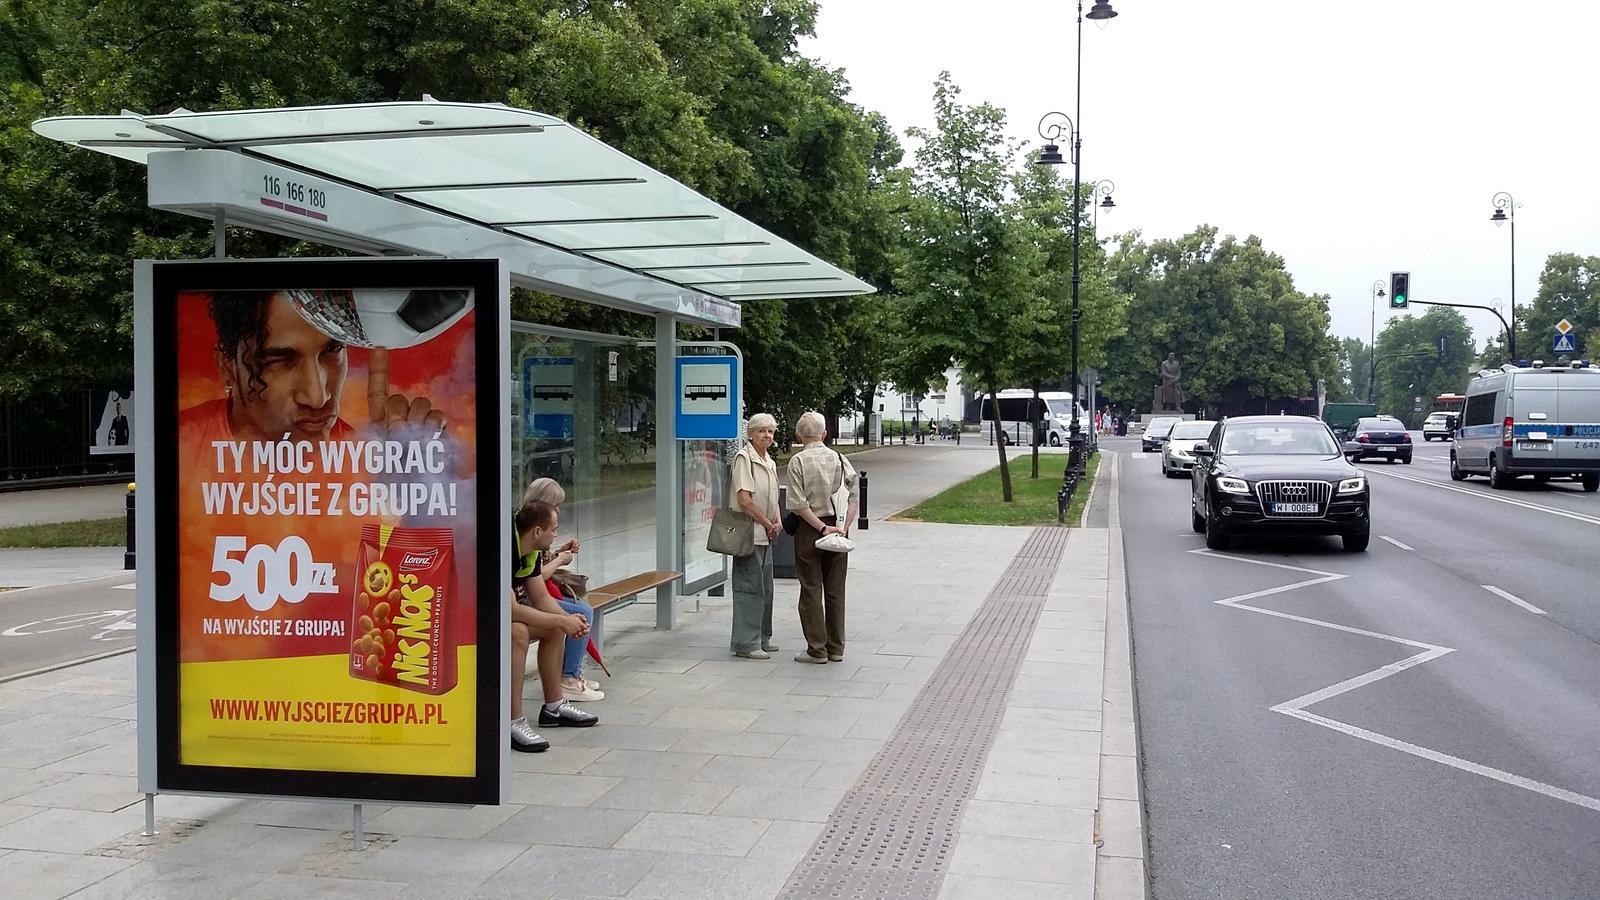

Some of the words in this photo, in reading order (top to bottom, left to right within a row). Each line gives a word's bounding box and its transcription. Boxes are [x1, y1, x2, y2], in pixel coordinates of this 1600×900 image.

[264, 174, 280, 196] 116
[286, 181, 304, 202] 166
[308, 188, 325, 209] 180
[211, 441, 247, 474] TY
[253, 432, 313, 474] MÓC
[320, 432, 445, 474] WYGRAĆ
[202, 474, 321, 516] WYJŚCIE
[327, 483, 343, 516] Z
[349, 483, 457, 516] GRUPA!
[404, 554, 430, 564] Lorenz
[203, 618, 222, 634] NA
[225, 615, 281, 636] WYJŚCIE
[284, 619, 292, 636] Z
[296, 620, 345, 637] GRUPA!
[210, 698, 448, 725] WWW.WYJSCIEZGRUPA.PL
